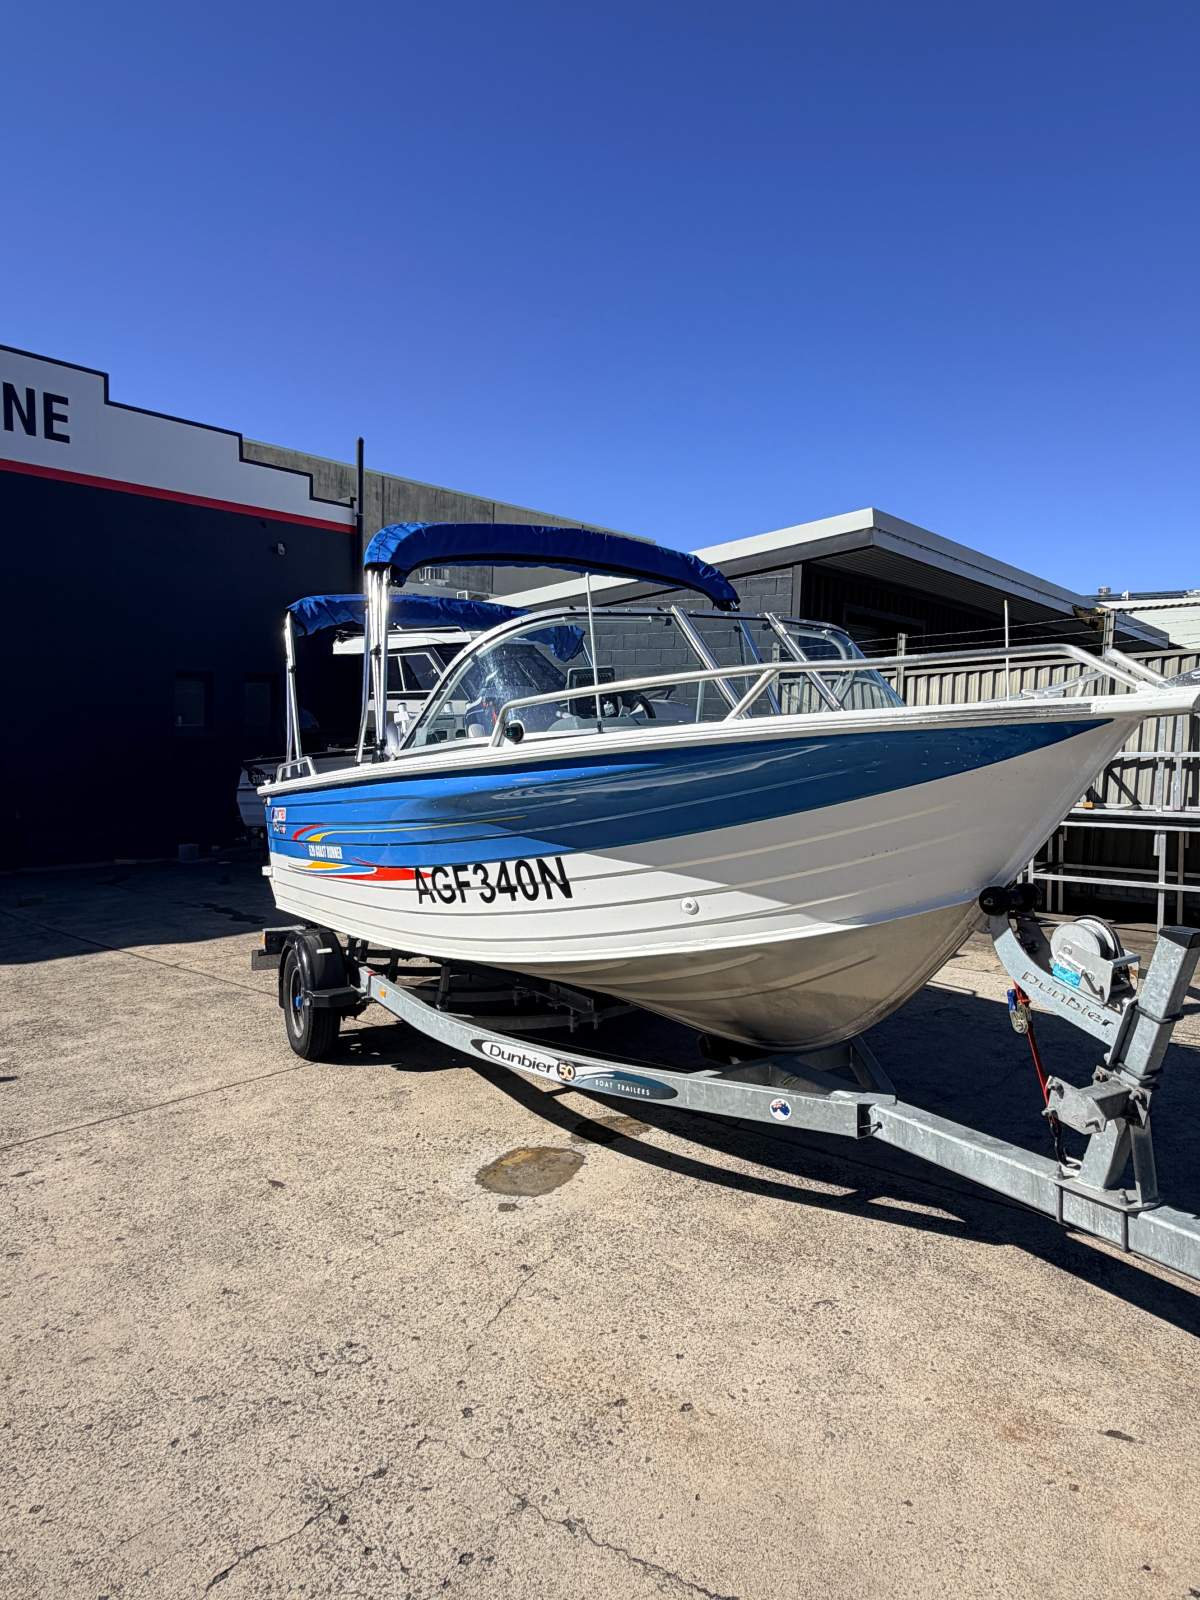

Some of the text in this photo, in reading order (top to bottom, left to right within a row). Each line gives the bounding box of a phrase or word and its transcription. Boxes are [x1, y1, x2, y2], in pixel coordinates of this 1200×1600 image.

[2, 381, 70, 444] NE
[414, 856, 574, 905] AGF340N
[1021, 970, 1115, 1028] Dunbier
[489, 1043, 555, 1074] Dunbier
[595, 1079, 651, 1097] BOAT TRAILERS
